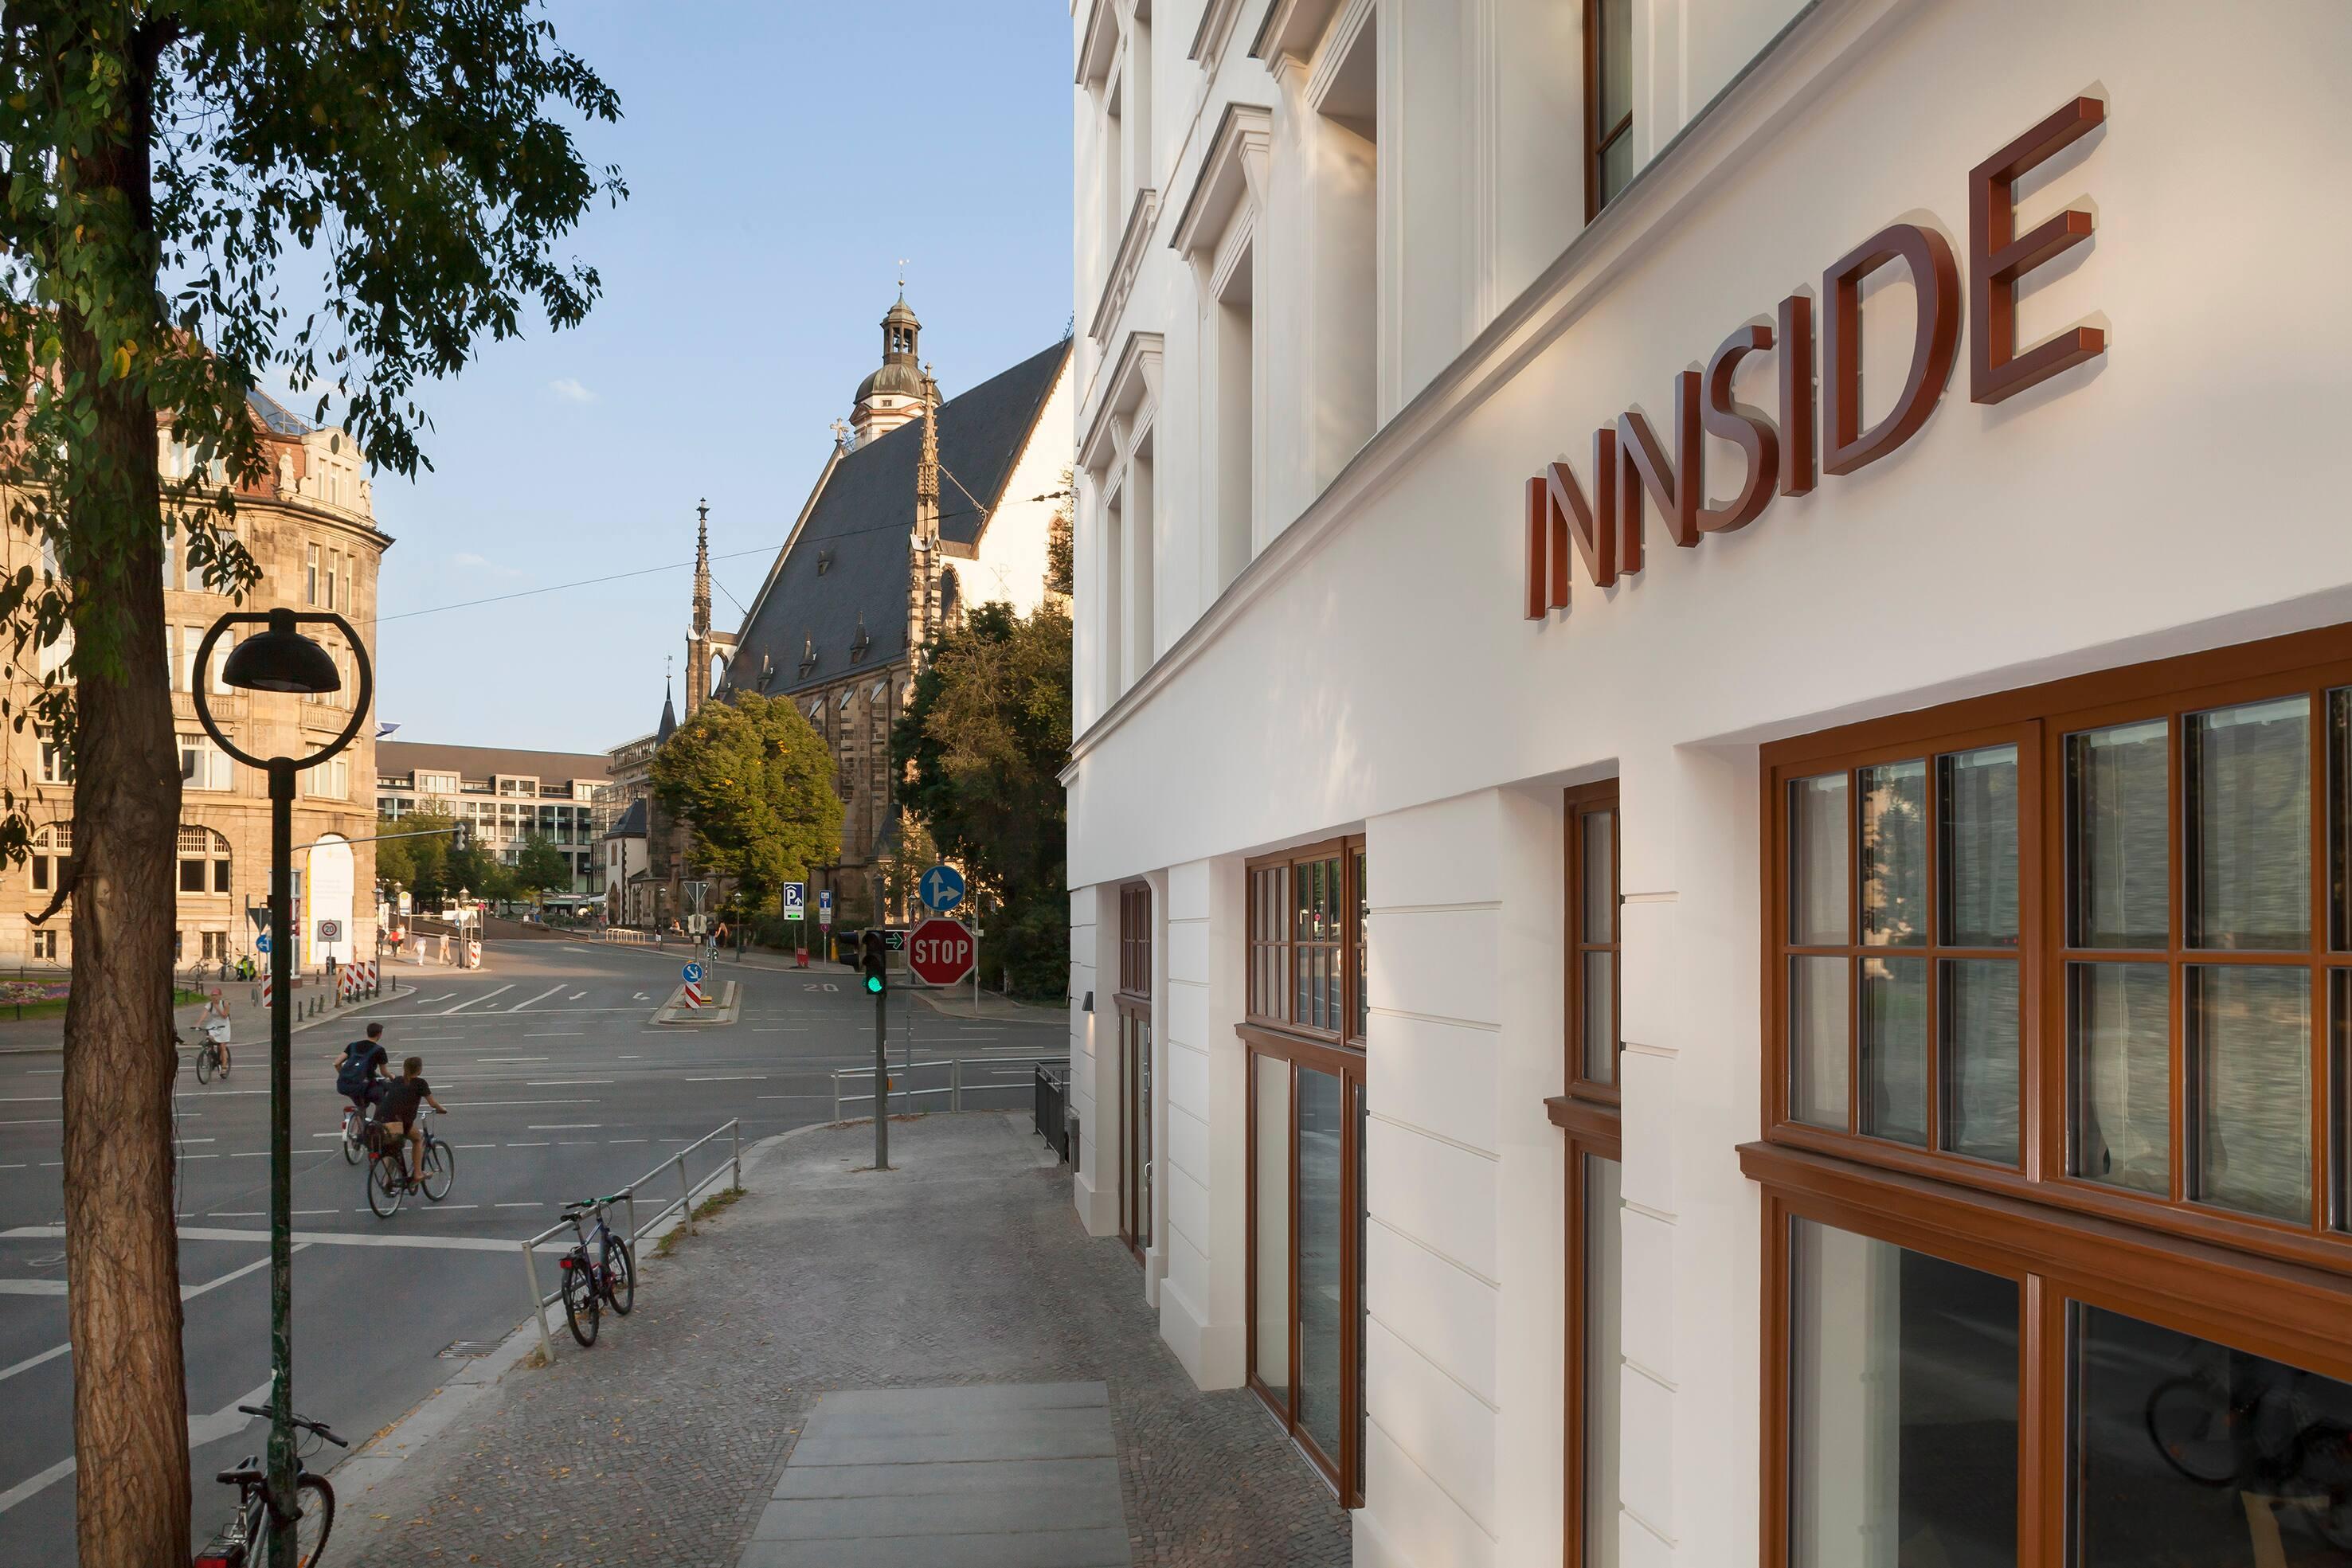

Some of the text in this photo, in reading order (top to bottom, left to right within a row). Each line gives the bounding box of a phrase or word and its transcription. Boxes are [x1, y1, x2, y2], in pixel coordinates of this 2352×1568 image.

[1524, 96, 2105, 621] INNSIDE
[787, 889, 796, 905] P
[915, 940, 969, 964] STOP
